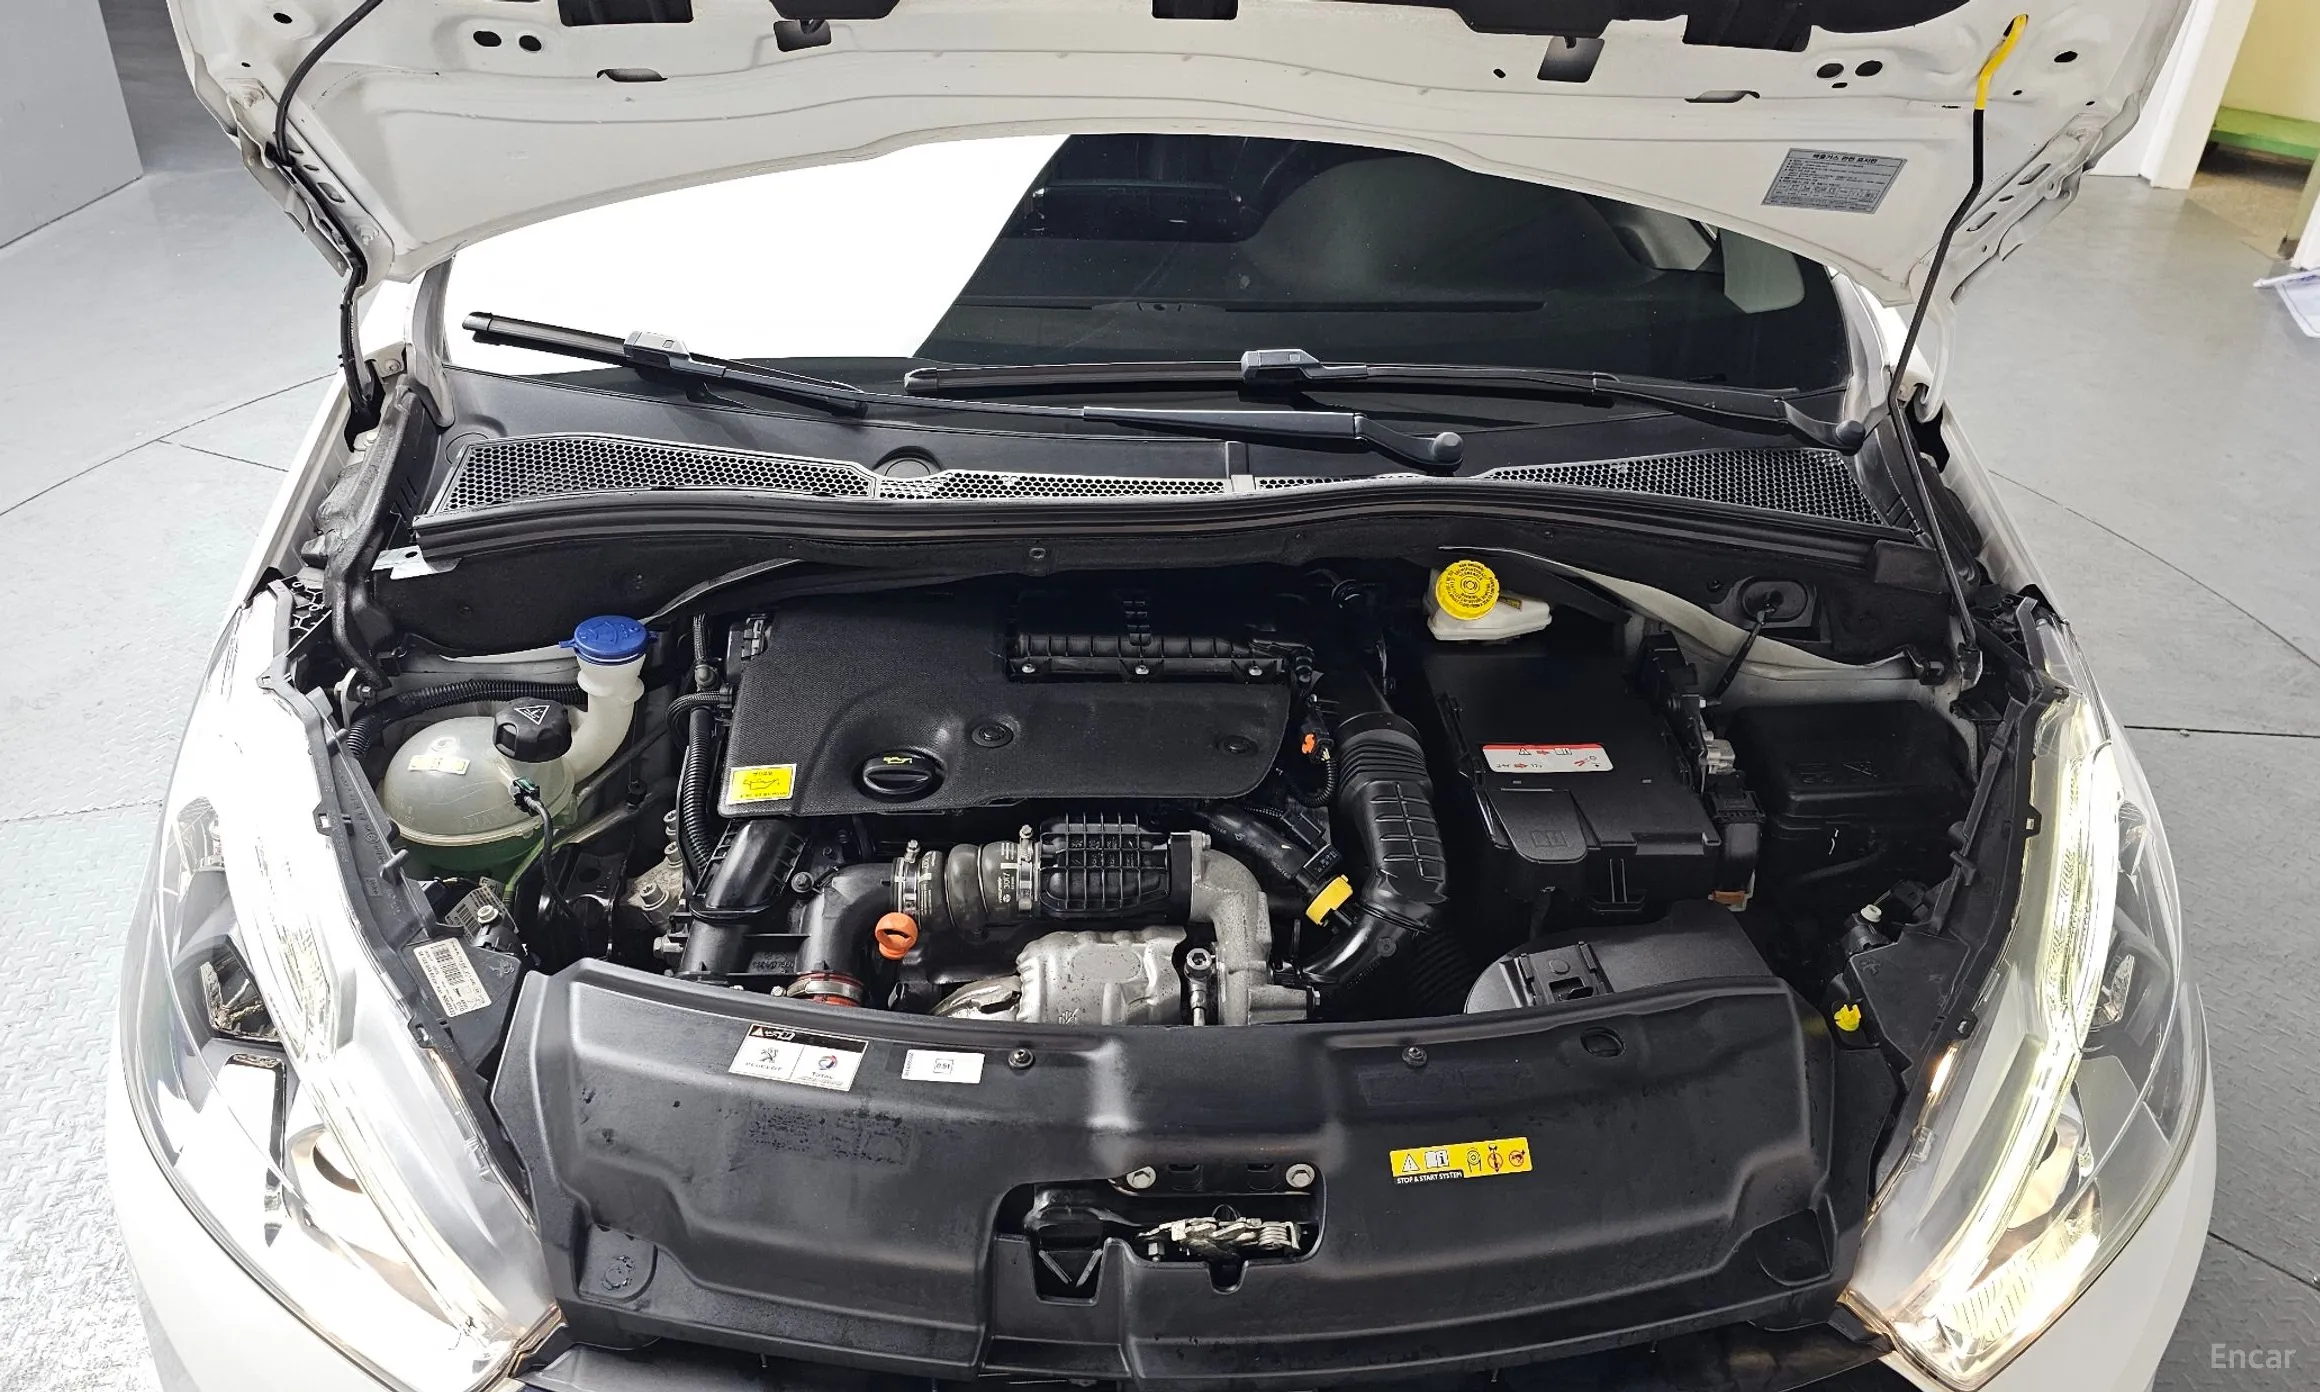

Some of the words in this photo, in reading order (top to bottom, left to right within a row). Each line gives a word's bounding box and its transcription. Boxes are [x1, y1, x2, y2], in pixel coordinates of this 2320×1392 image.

[1397, 1175, 1413, 1184] STOP
[1419, 1174, 1438, 1182] START
[1439, 1171, 1462, 1179] SYSTEM
